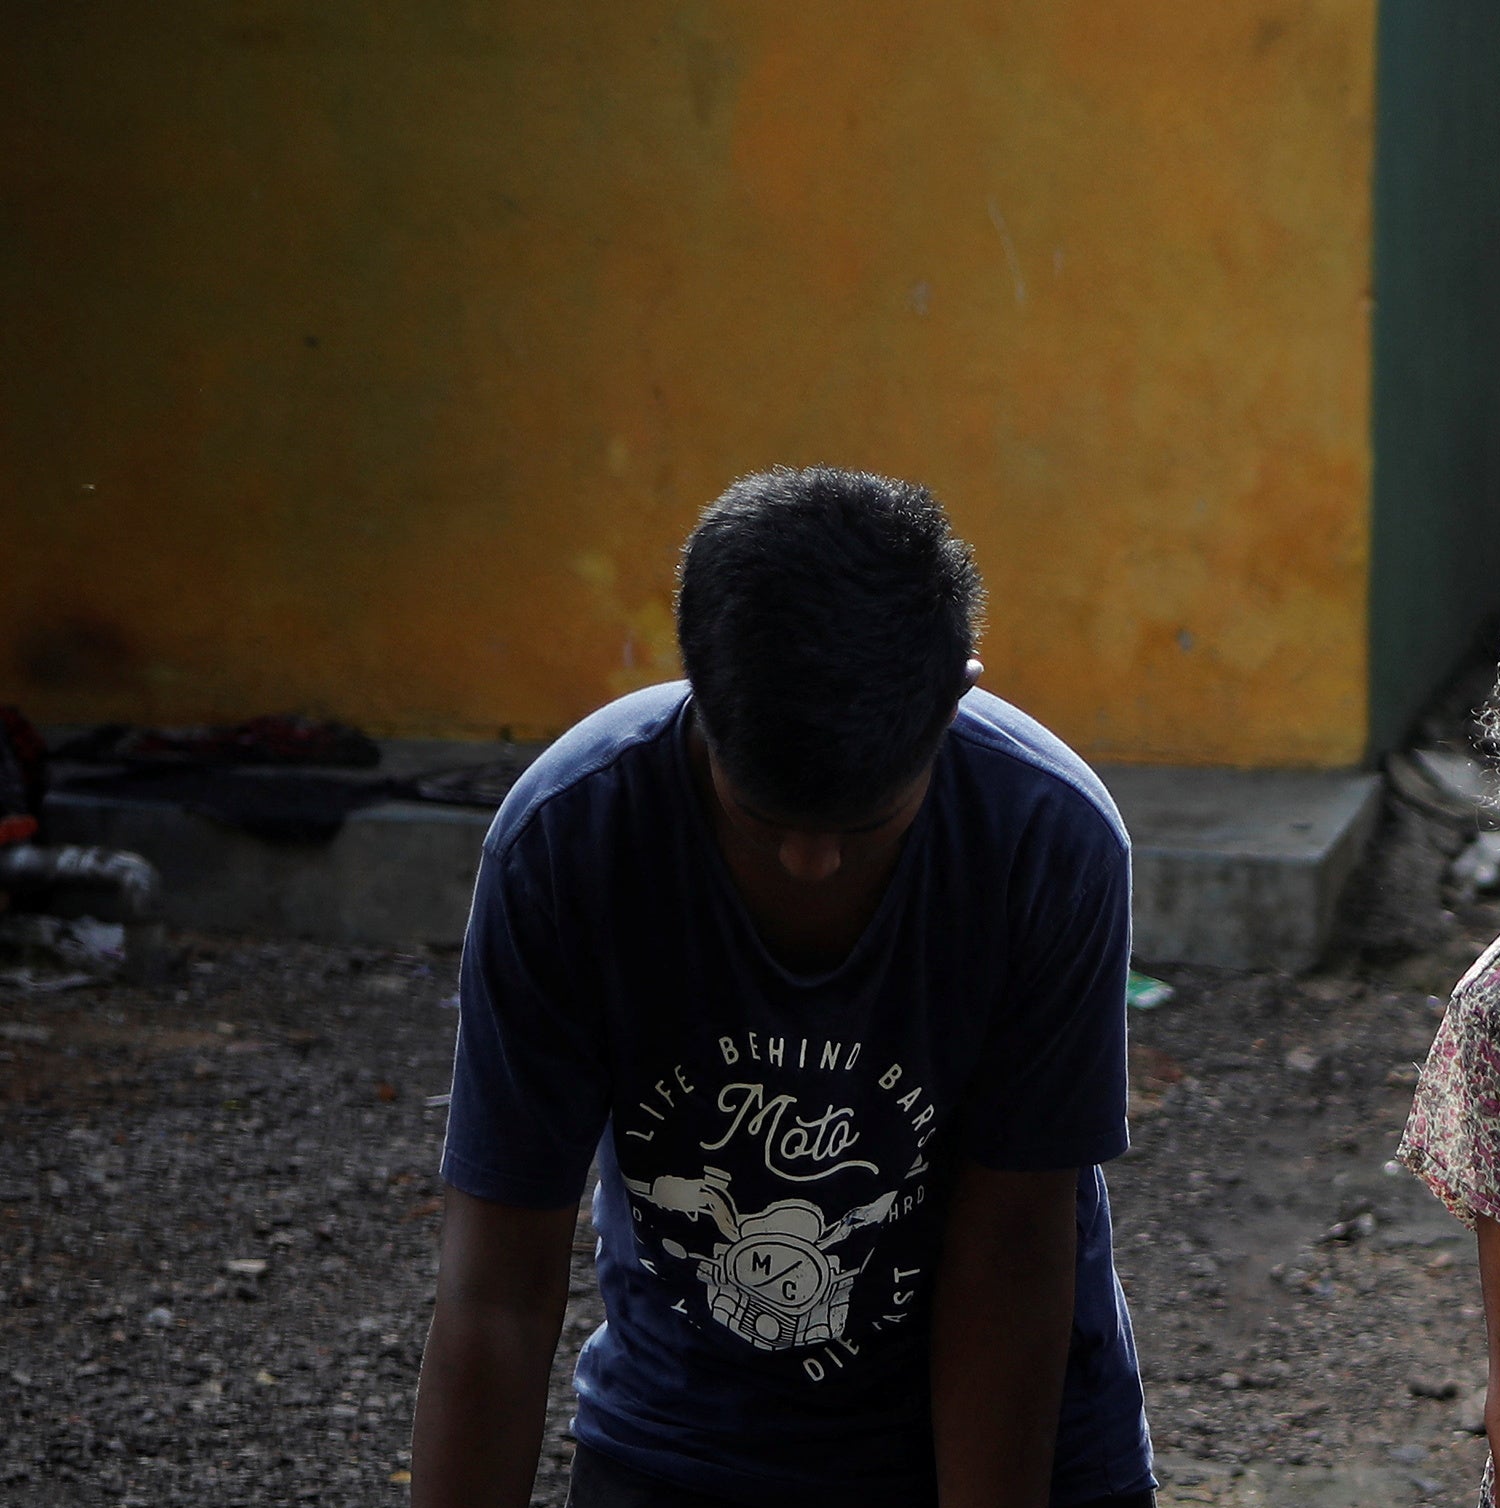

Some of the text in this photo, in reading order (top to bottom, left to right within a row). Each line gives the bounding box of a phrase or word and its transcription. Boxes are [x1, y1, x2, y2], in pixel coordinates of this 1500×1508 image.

[626, 1032, 937, 1149] LIFE BEHIND BARS
[699, 1083, 880, 1182] Moto
[802, 1266, 922, 1383] DIE AST
